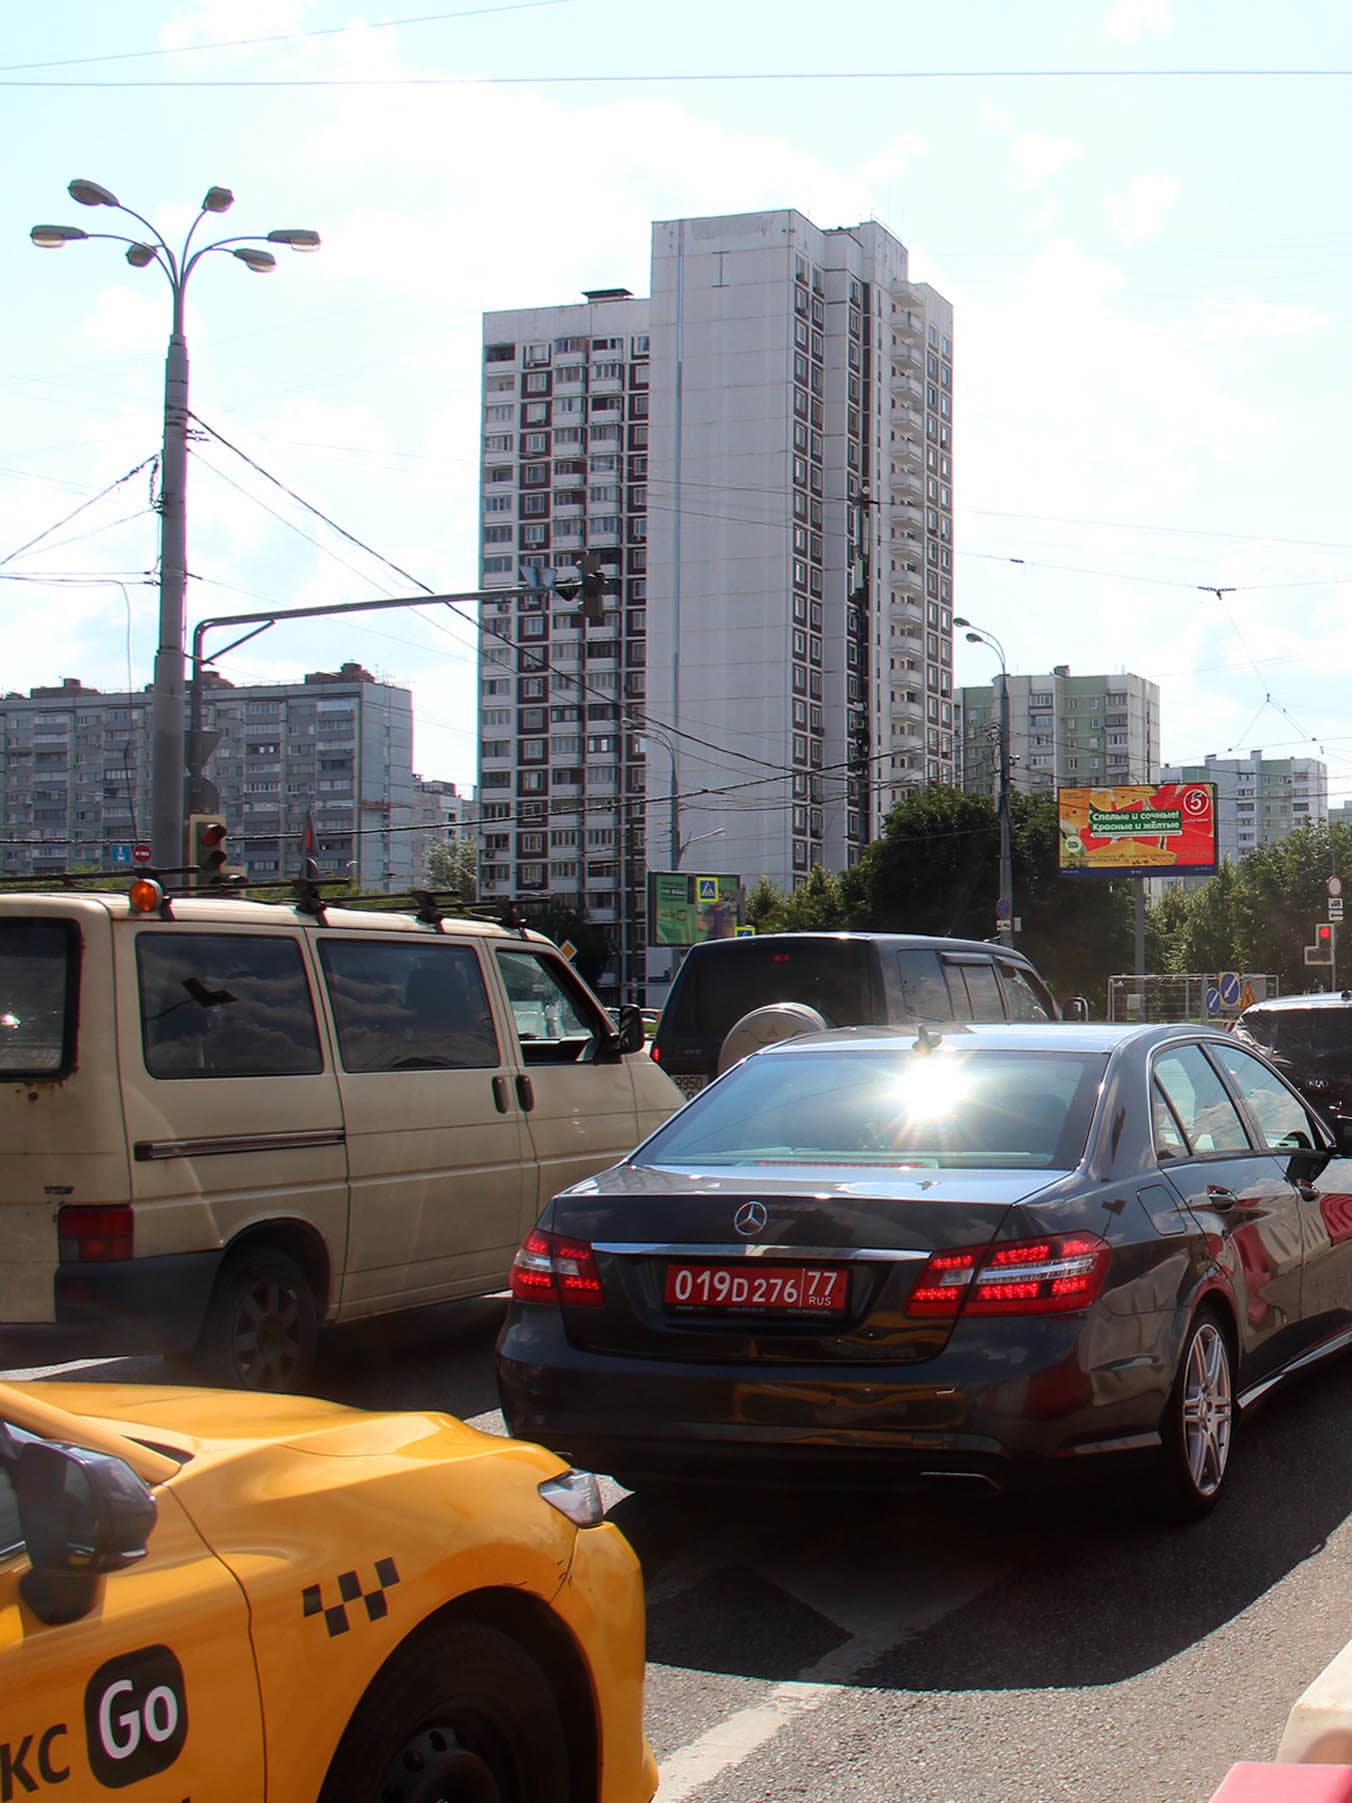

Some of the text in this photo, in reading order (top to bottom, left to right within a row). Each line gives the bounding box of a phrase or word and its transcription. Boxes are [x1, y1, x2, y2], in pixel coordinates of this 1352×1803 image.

[1092, 813, 1130, 821] Спелые
[1140, 811, 1180, 820] сочные!
[1093, 823, 1133, 832] Красные
[1143, 821, 1180, 830] жёлтые
[807, 1271, 838, 1296] 77
[808, 1296, 832, 1306] RUS
[100, 1679, 178, 1760] Go
